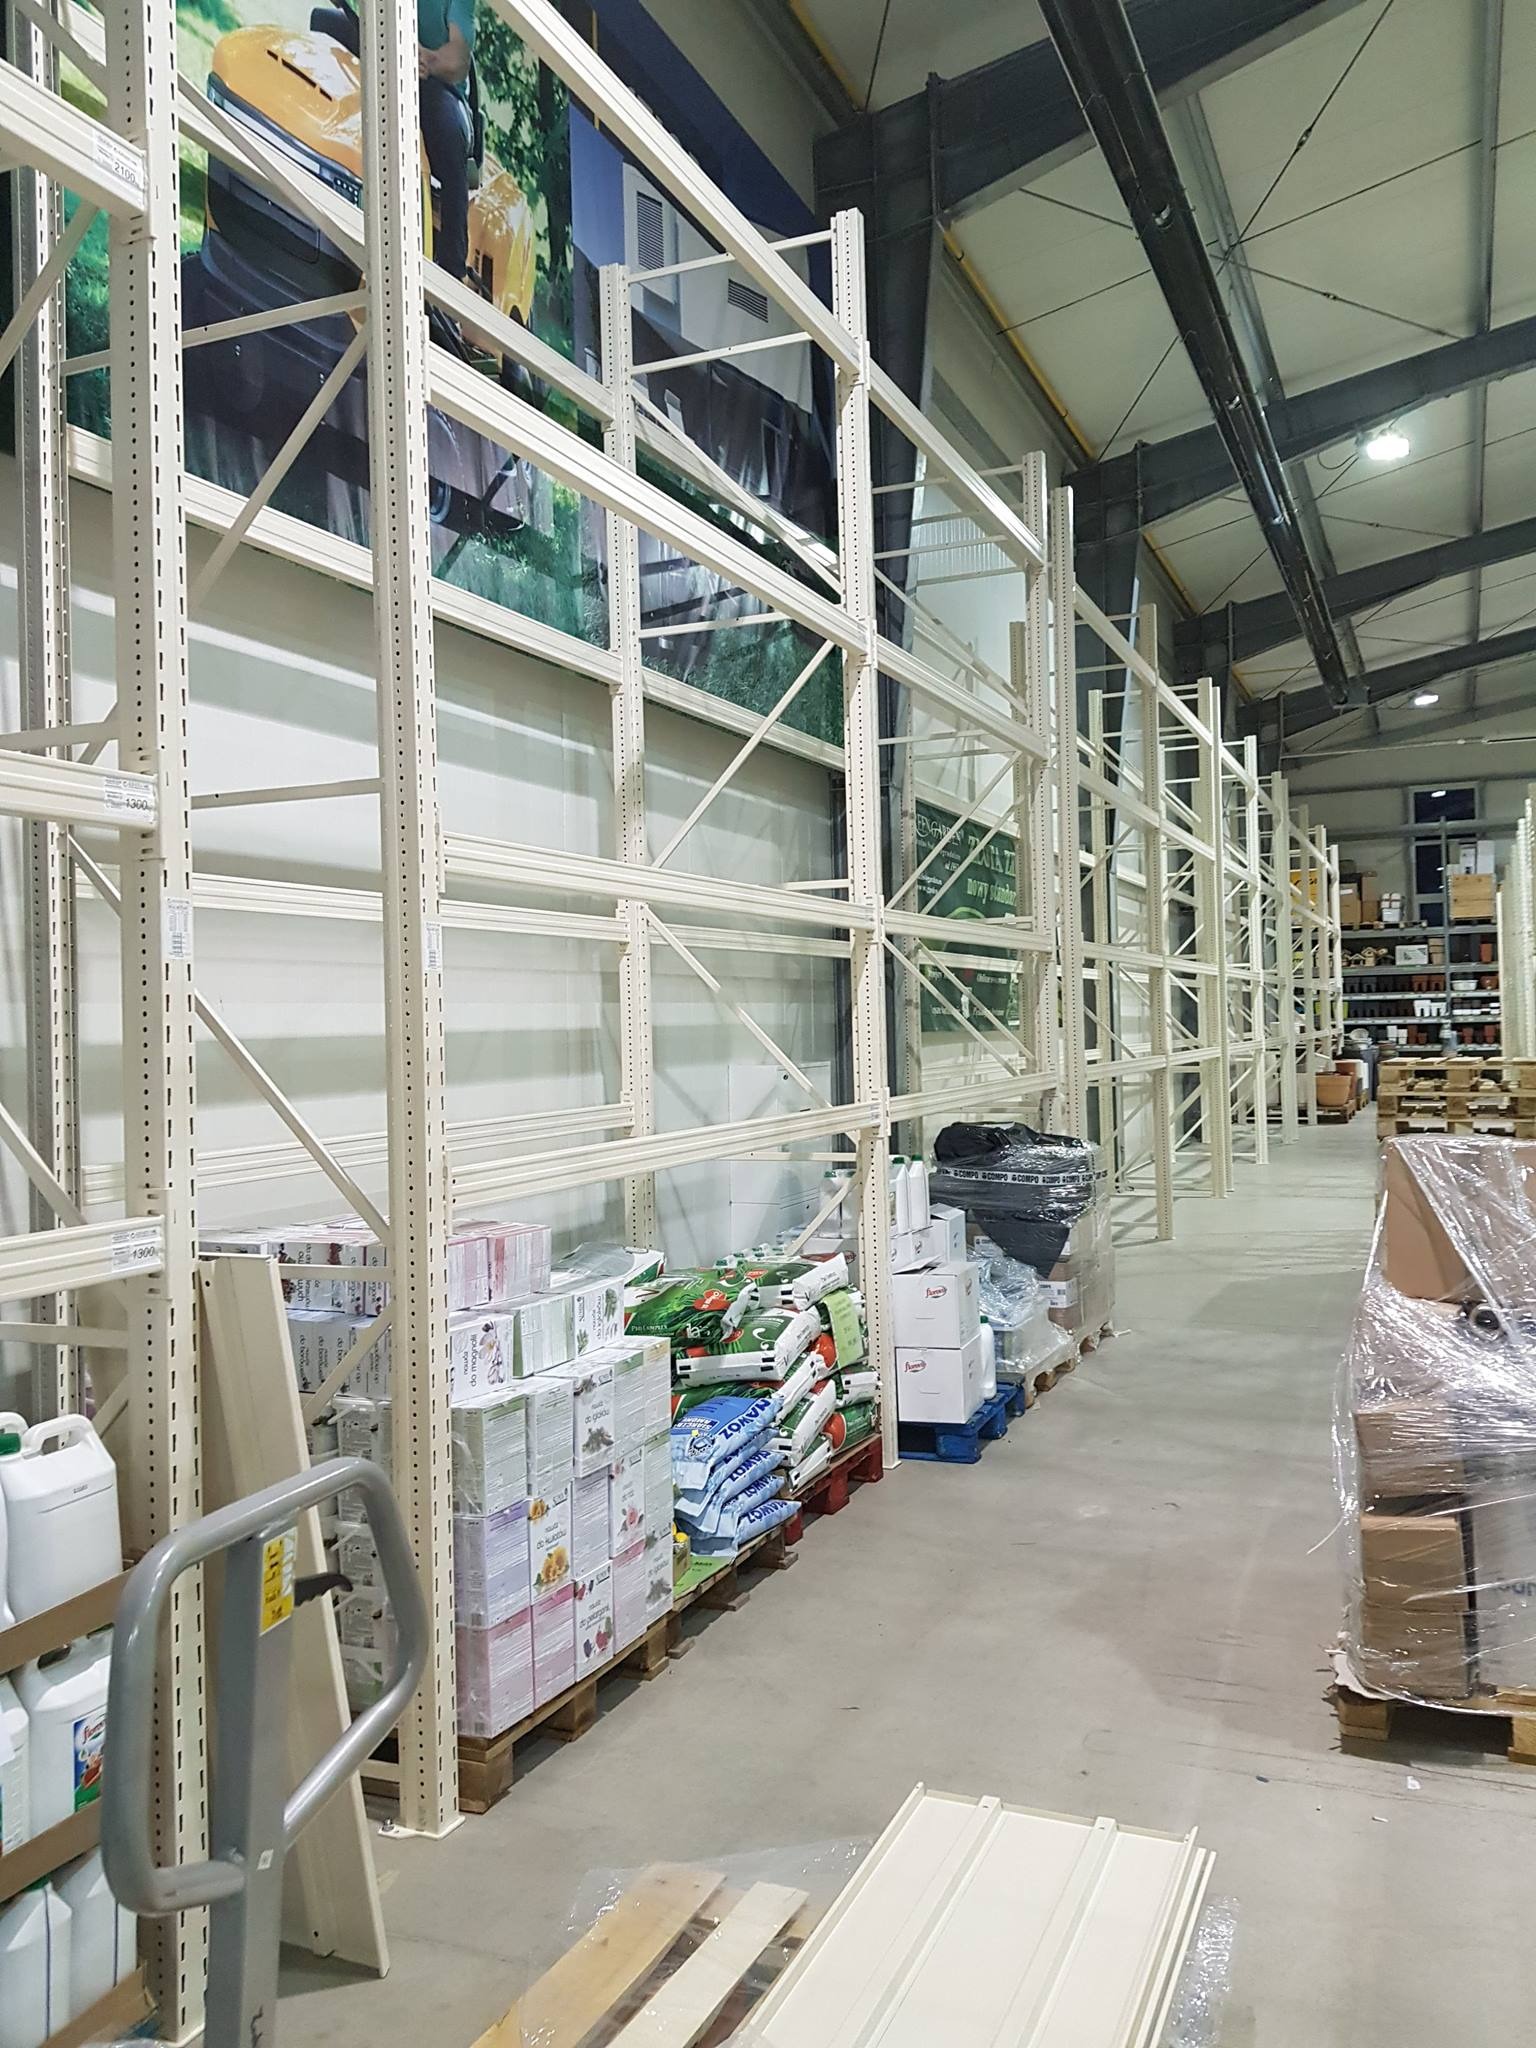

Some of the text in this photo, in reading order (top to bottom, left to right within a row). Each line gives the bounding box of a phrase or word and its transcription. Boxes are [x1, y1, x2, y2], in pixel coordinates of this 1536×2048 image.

[114, 161, 136, 184] 2100
[126, 798, 148, 810] 1300
[967, 878, 989, 904] nowy
[959, 1170, 979, 1179] COMPO
[987, 1172, 1008, 1181] COMPO
[1018, 1174, 1039, 1183] COMPO
[132, 1246, 155, 1259] 1300
[470, 1334, 479, 1387] do magnolii
